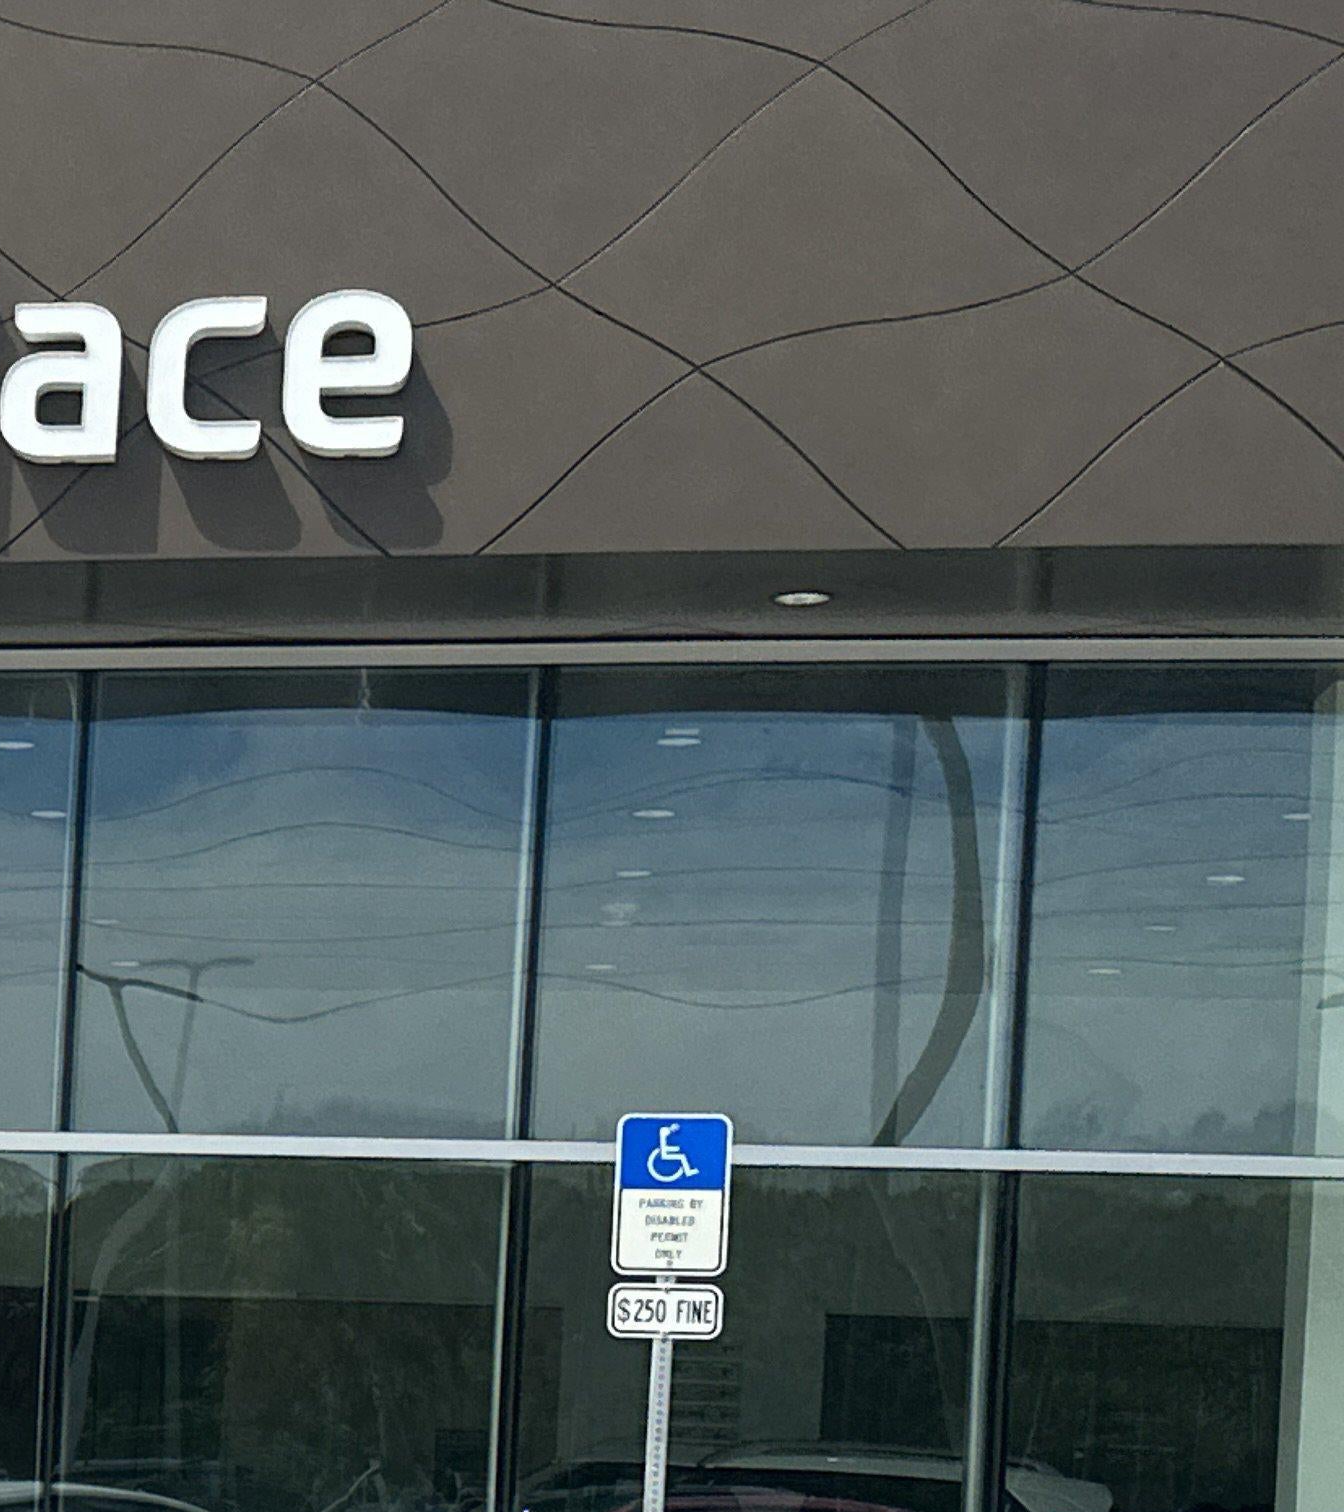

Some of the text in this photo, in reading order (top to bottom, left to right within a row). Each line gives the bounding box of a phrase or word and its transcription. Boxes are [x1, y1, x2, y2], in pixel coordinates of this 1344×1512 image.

[690, 1198, 704, 1210] BY
[617, 1298, 713, 1325] $250 FINE
